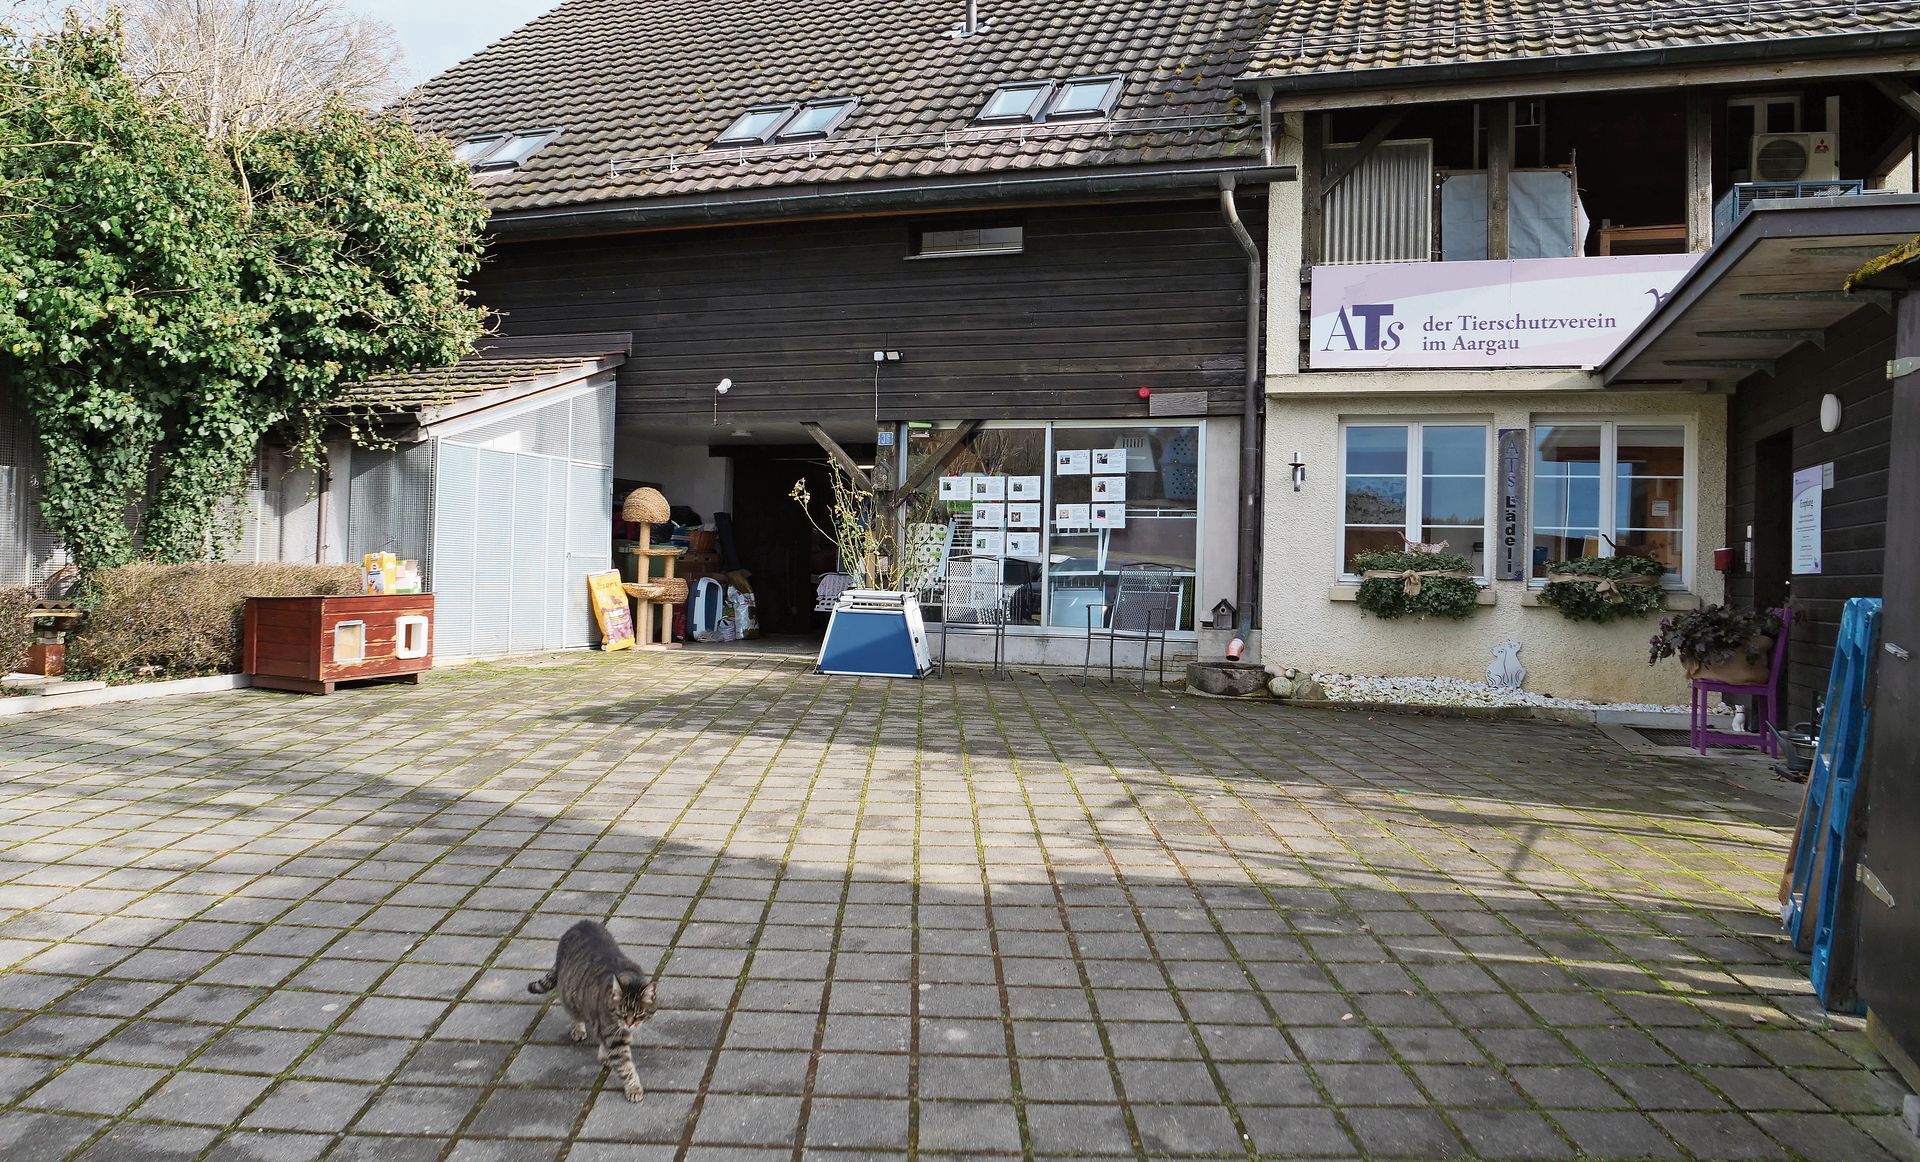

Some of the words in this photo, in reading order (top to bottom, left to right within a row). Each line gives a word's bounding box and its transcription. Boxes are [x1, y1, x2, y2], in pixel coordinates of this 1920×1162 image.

[1423, 315, 1453, 332] der
[1458, 313, 1617, 331] Tierschutzverein
[1423, 336, 1448, 351] im
[1452, 336, 1521, 356] Aargau
